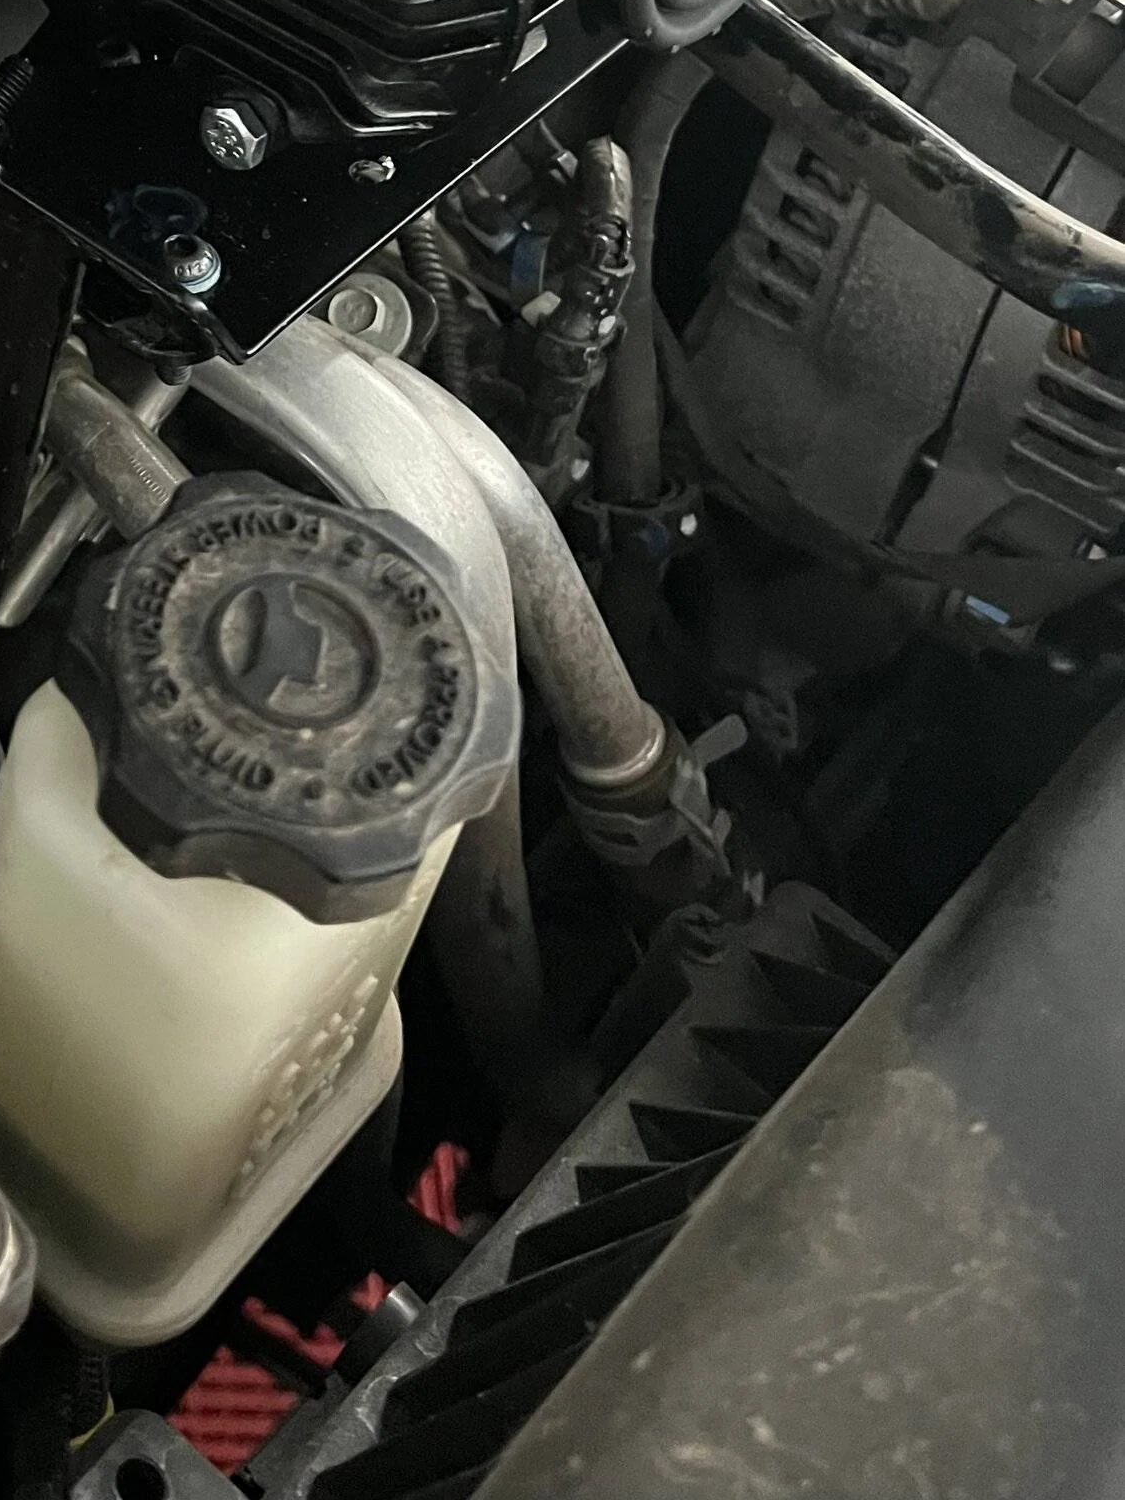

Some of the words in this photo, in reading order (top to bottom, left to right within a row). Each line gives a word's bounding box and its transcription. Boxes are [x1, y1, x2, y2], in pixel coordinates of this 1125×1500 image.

[188, 508, 326, 552] POWER
[129, 547, 192, 709] STEERING
[375, 553, 443, 629] USE
[180, 709, 276, 793] FLUID
[349, 634, 461, 799] APPROVED
